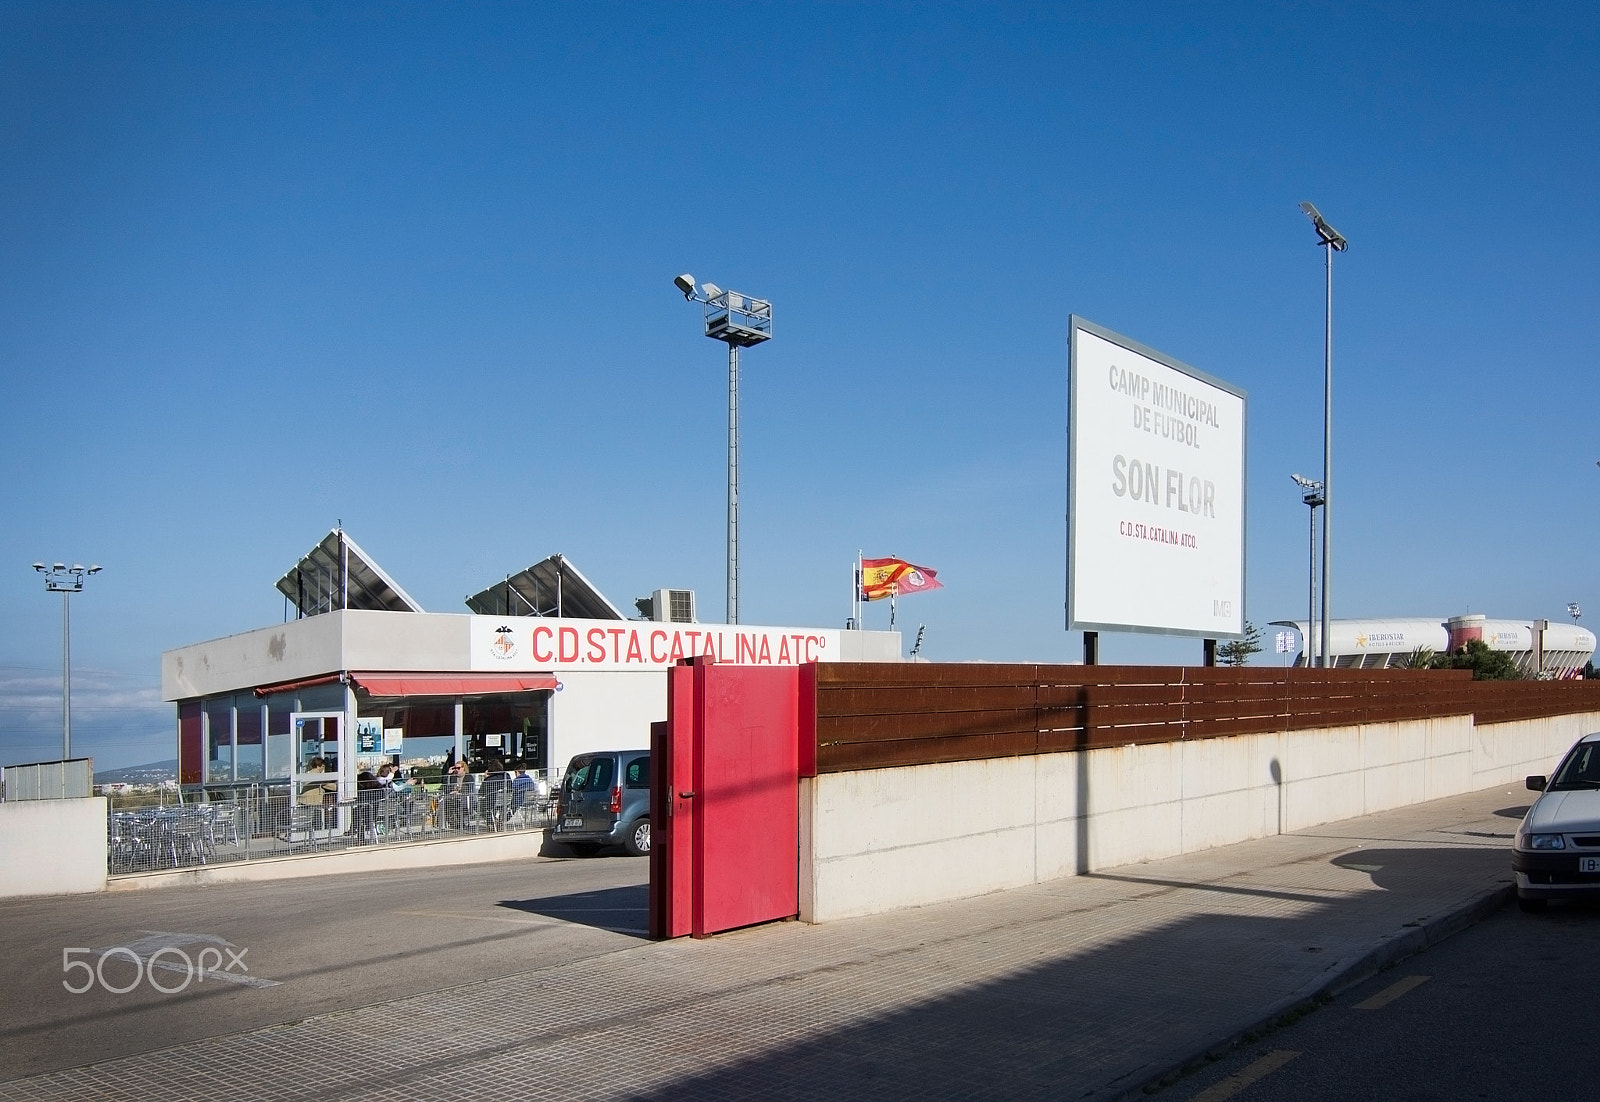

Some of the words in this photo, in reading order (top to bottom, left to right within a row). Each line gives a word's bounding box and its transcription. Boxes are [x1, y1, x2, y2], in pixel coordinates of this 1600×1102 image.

[1109, 365, 1150, 400] CAMP
[1152, 381, 1219, 429] MUNICIPAL
[1133, 404, 1151, 433] DE
[1153, 411, 1200, 449] FUTBOL
[1112, 454, 1159, 505] SON
[1166, 469, 1215, 519] FLOR
